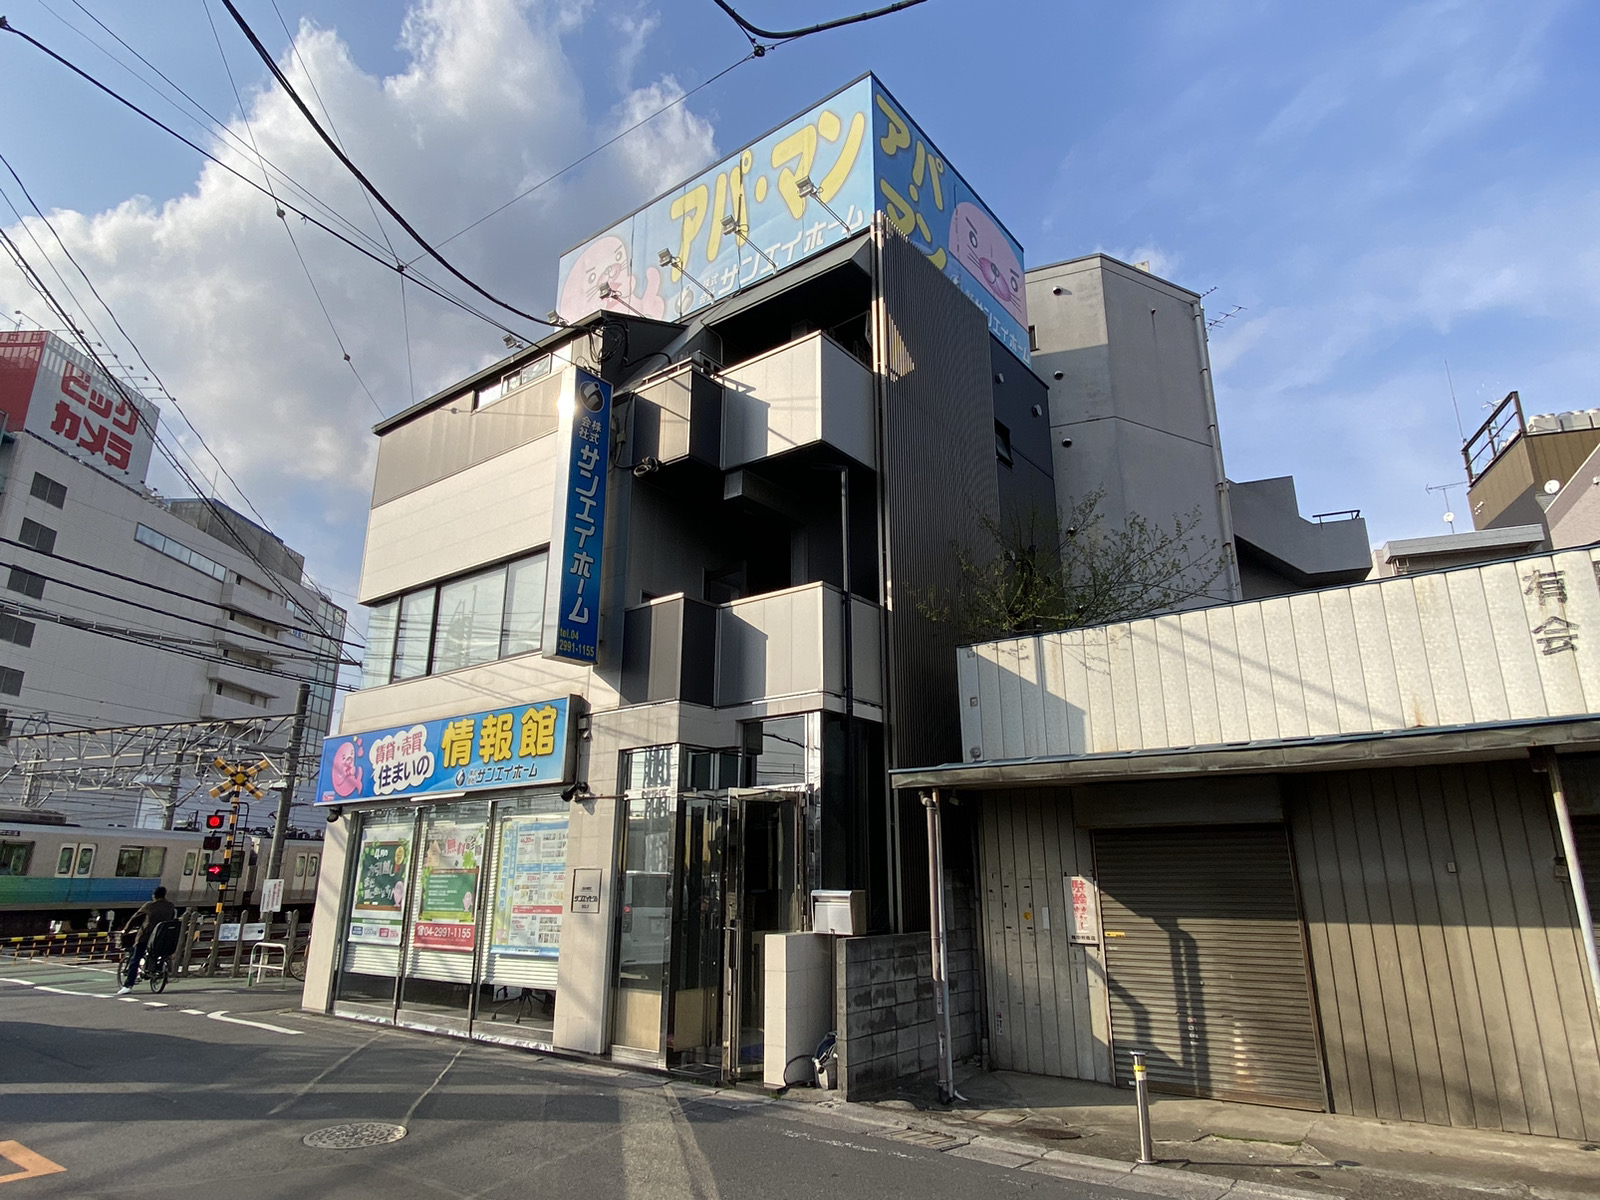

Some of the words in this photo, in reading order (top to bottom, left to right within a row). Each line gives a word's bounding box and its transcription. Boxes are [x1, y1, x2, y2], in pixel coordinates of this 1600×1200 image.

[669, 110, 866, 283] アパ・マン
[61, 361, 140, 436] ビック
[50, 400, 133, 471] カメラ
[568, 444, 600, 624] サンエイホーム
[375, 731, 423, 764] 賃貸・売買
[441, 704, 558, 769] 情報館
[378, 755, 430, 789] 住まいの
[476, 762, 538, 784] サンエイホーム
[424, 926, 472, 939] 04-2991-1155
